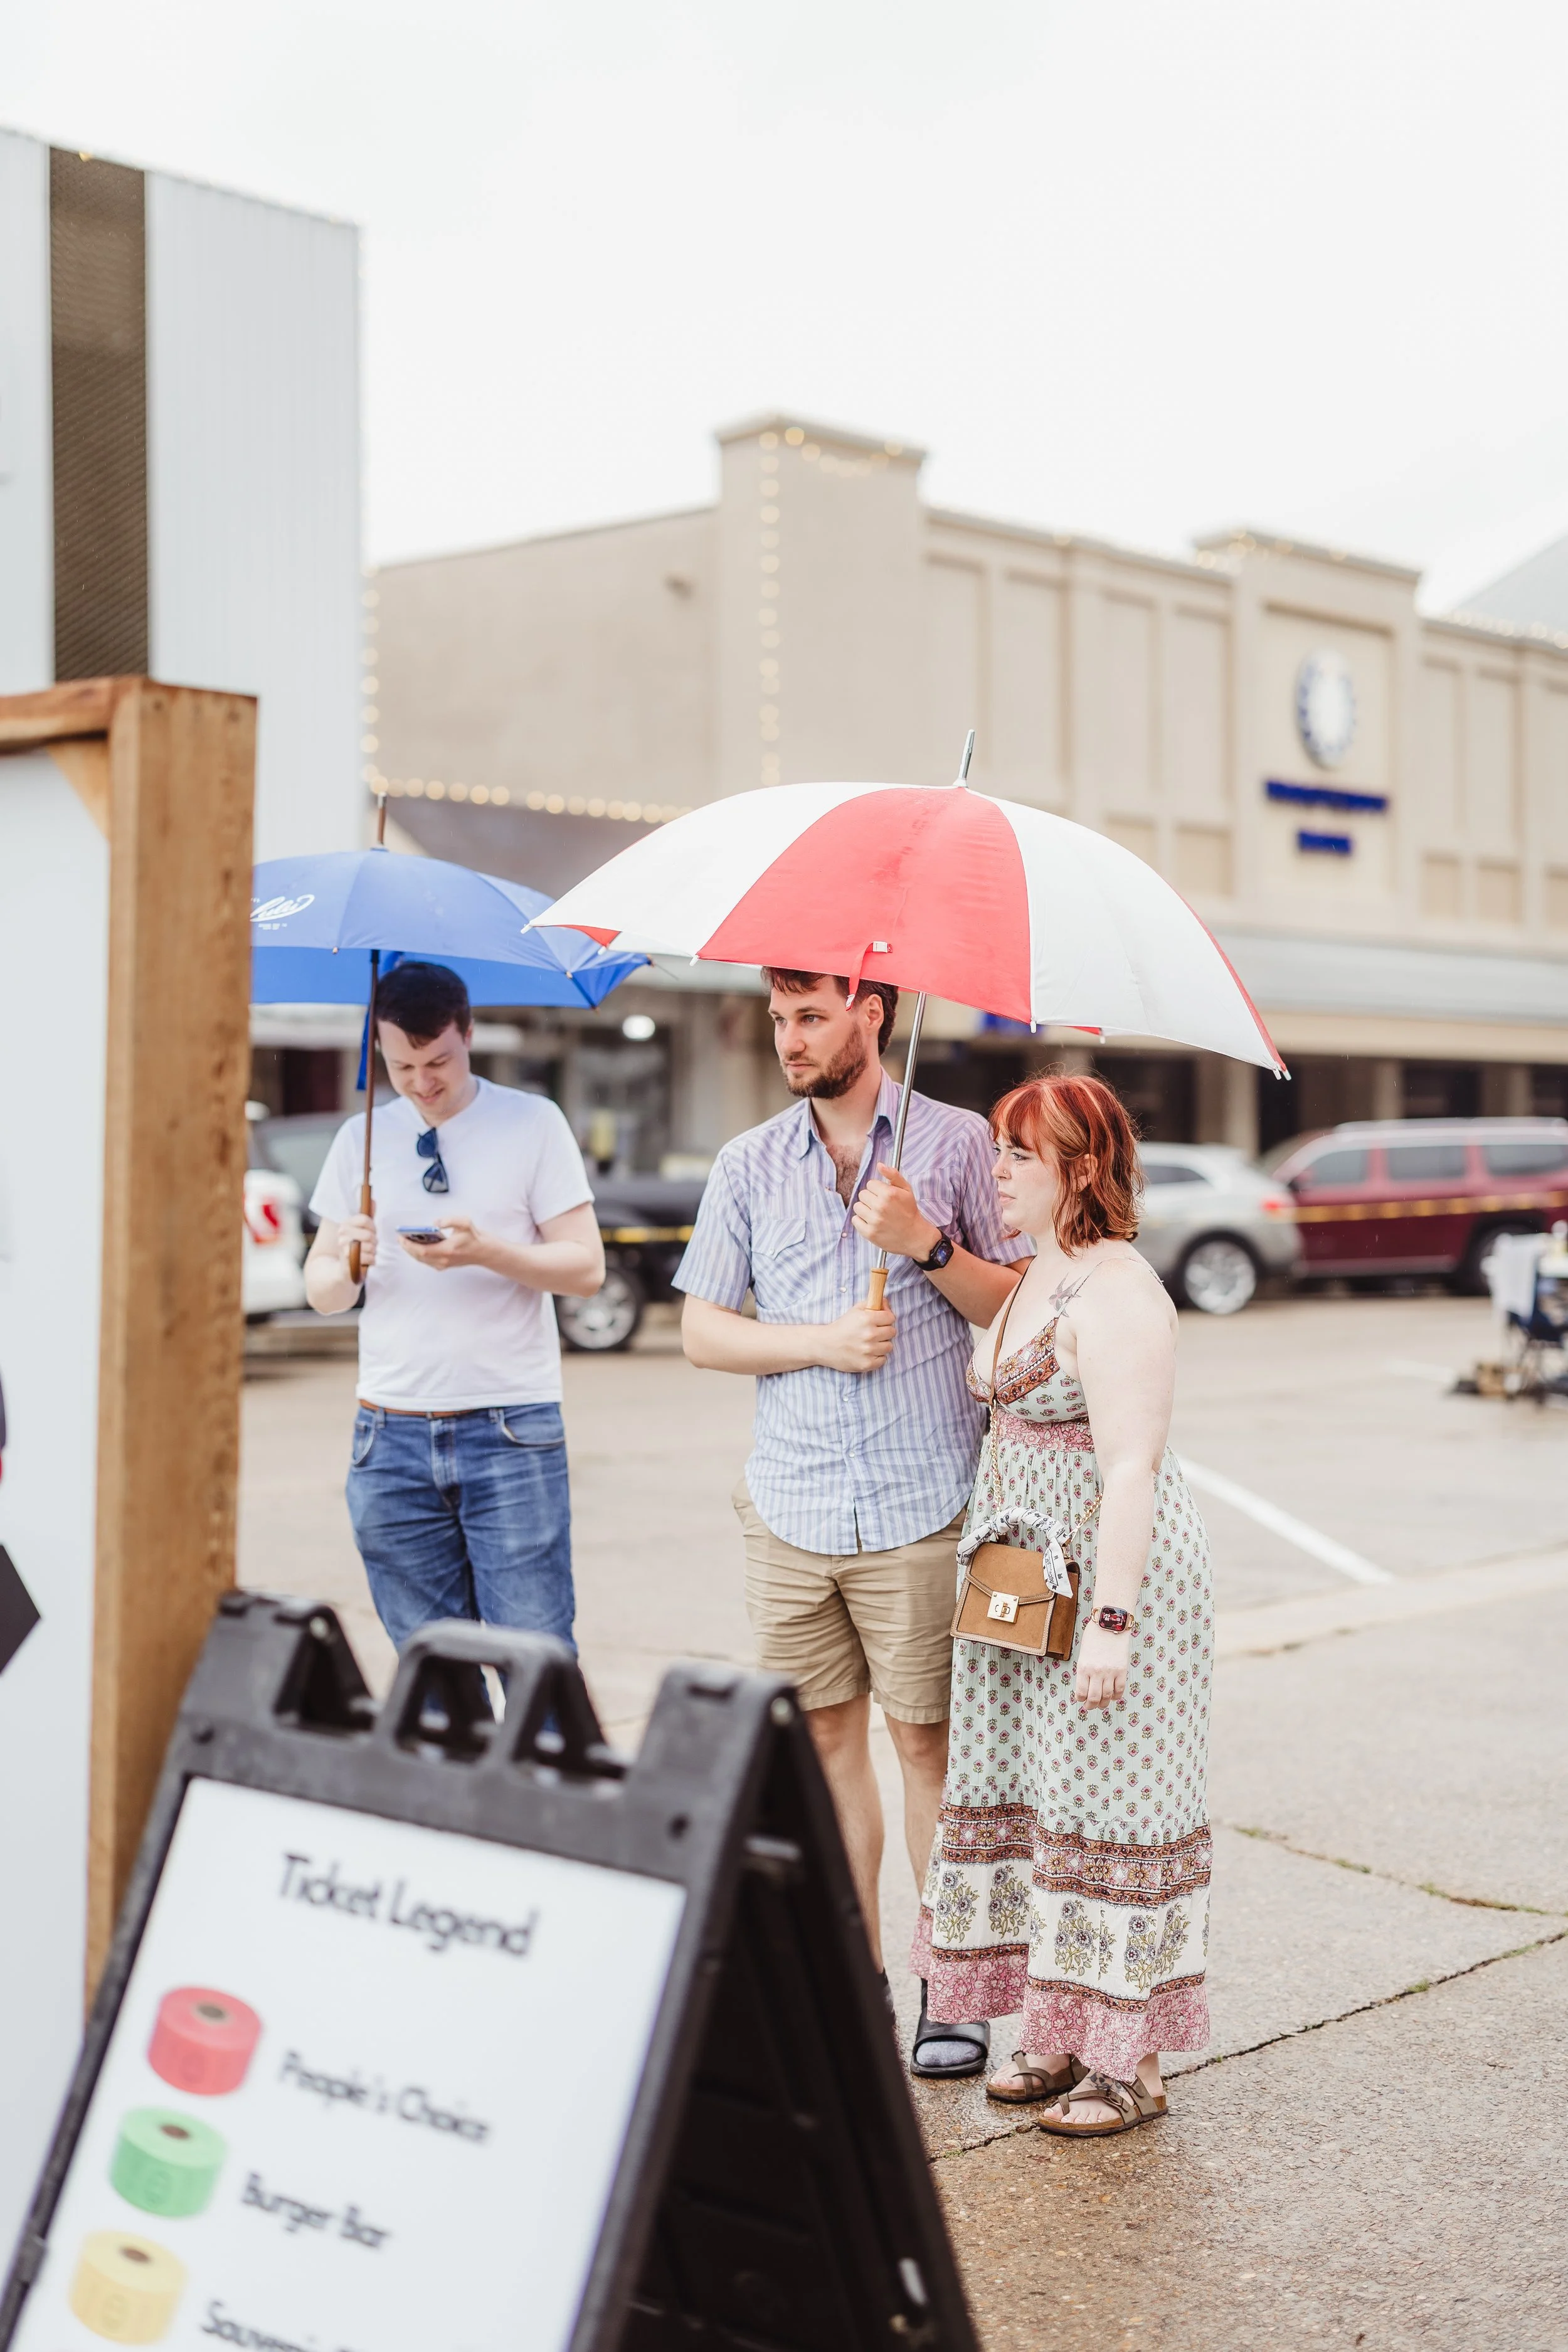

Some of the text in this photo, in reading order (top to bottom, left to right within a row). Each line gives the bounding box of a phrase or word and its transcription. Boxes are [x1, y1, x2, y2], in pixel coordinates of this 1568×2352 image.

[280, 1851, 539, 1958] Ticket Legend
[280, 2049, 490, 2144] People's Choice
[240, 2171, 392, 2250] Burger Bar
